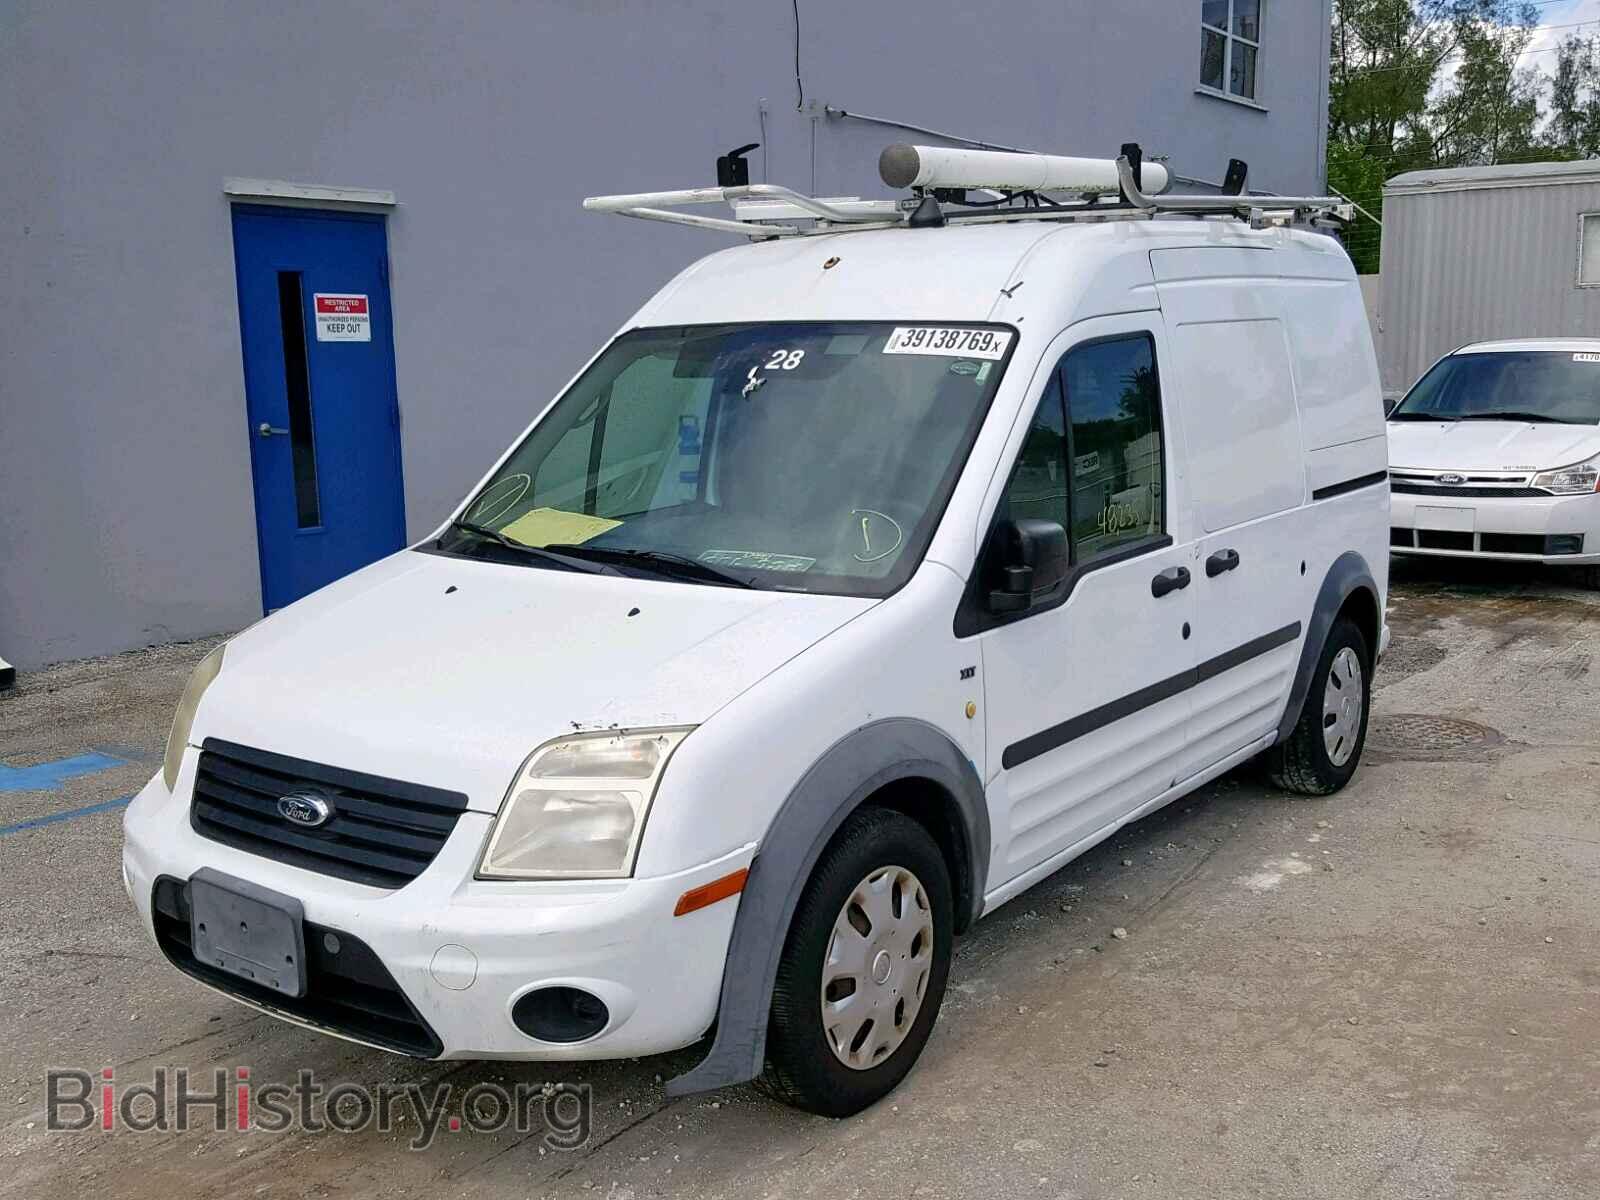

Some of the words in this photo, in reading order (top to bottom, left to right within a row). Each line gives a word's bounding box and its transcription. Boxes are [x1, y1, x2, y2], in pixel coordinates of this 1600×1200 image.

[327, 324, 345, 333] KEEP
[346, 324, 361, 333] OUT
[764, 349, 805, 370] 28
[1440, 474, 1459, 482] Ford
[286, 800, 312, 821] Ford
